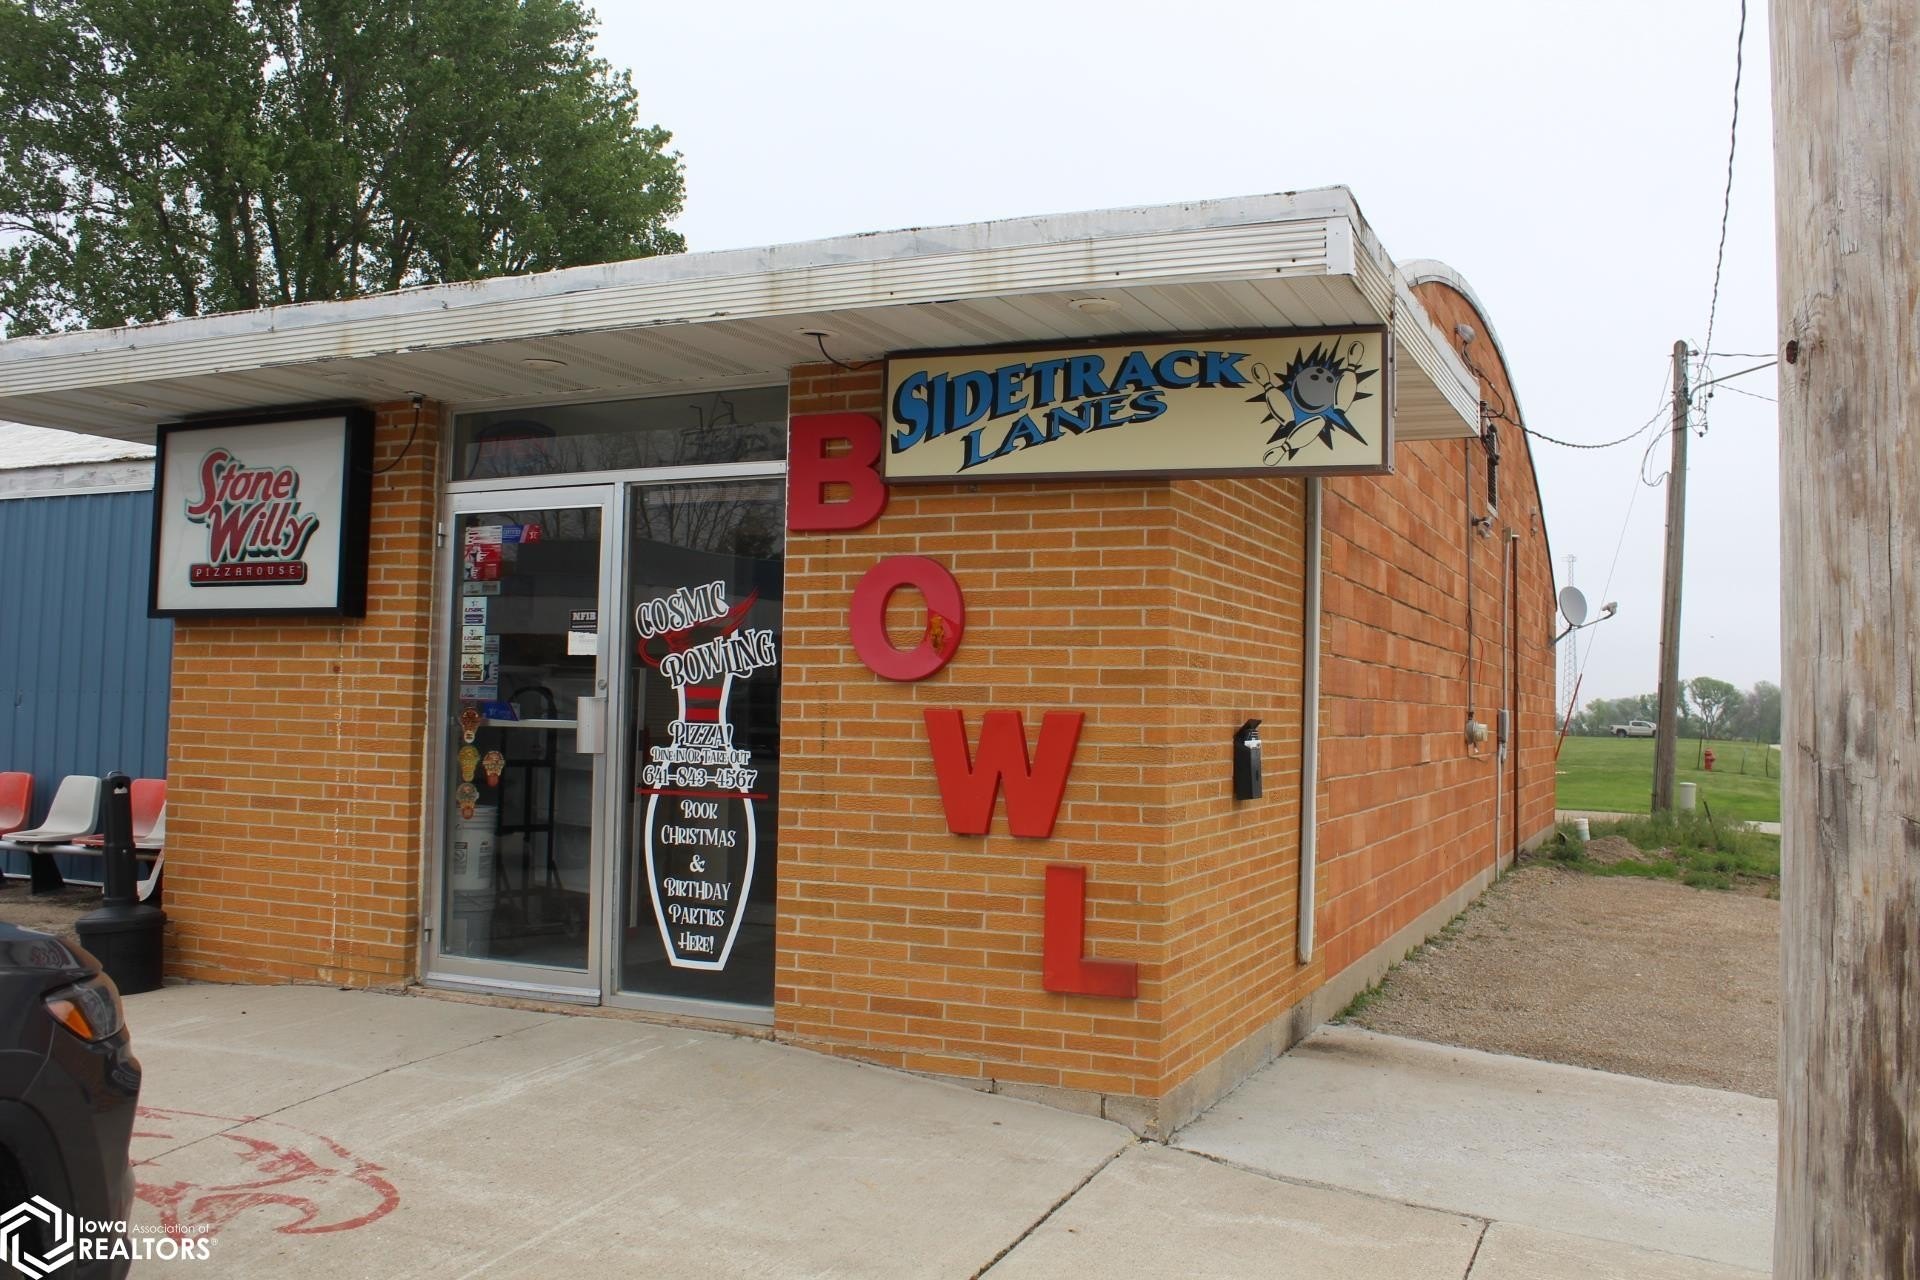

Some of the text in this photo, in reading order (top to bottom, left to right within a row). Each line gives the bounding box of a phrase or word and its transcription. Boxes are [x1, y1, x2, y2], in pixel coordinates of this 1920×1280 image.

[891, 350, 1253, 454] SIDETRACK
[956, 390, 1168, 473] LANES
[186, 448, 298, 520] Stone
[208, 501, 317, 565] Willy
[196, 565, 296, 577] PIZZAHOUSE
[572, 611, 597, 621] NFIB
[636, 580, 729, 639] COSMIC
[660, 627, 776, 690] BOWLING
[668, 721, 734, 748] PIZZA!
[650, 746, 751, 765] DINE IN OR TAKE OUT
[643, 765, 757, 788] 641-843-4567
[680, 799, 718, 819] BOOK
[660, 825, 737, 848] CHRISTMAS
[689, 854, 706, 873] &
[663, 877, 731, 901] BIRTHDAY
[668, 904, 725, 927] PARTIES
[677, 931, 714, 954] HERE!
